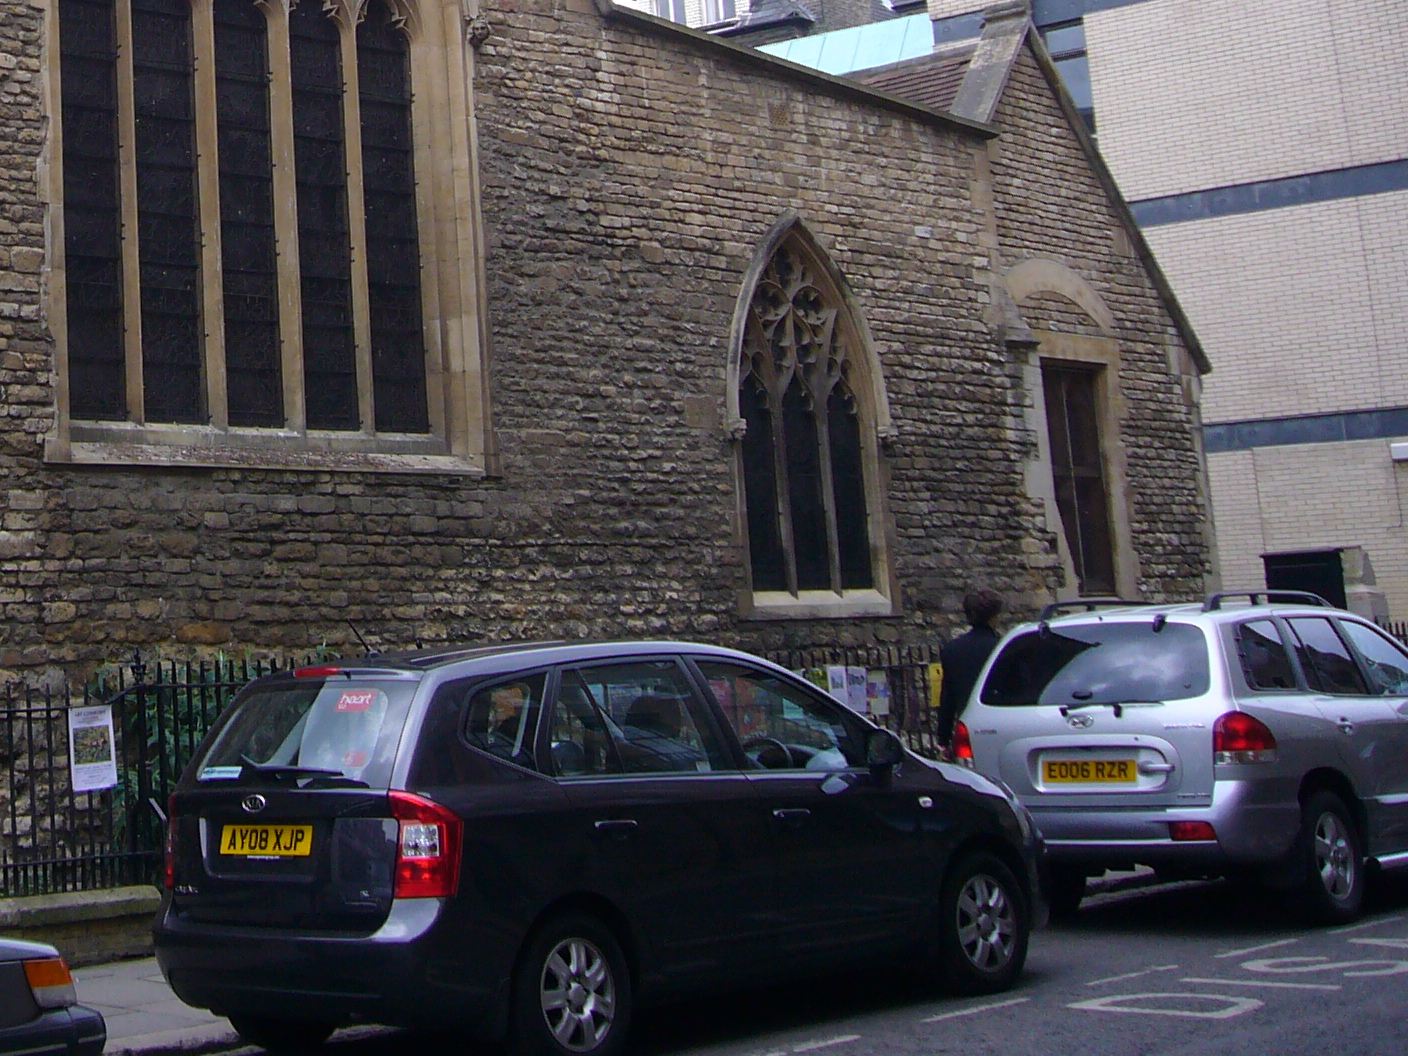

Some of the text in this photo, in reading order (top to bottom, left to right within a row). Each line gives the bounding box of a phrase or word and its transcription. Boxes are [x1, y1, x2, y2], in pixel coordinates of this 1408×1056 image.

[339, 693, 371, 704] heart
[1096, 762, 1129, 778] RZR
[227, 828, 304, 851] AY08 XJP
[1066, 938, 1408, 1019] DIS
